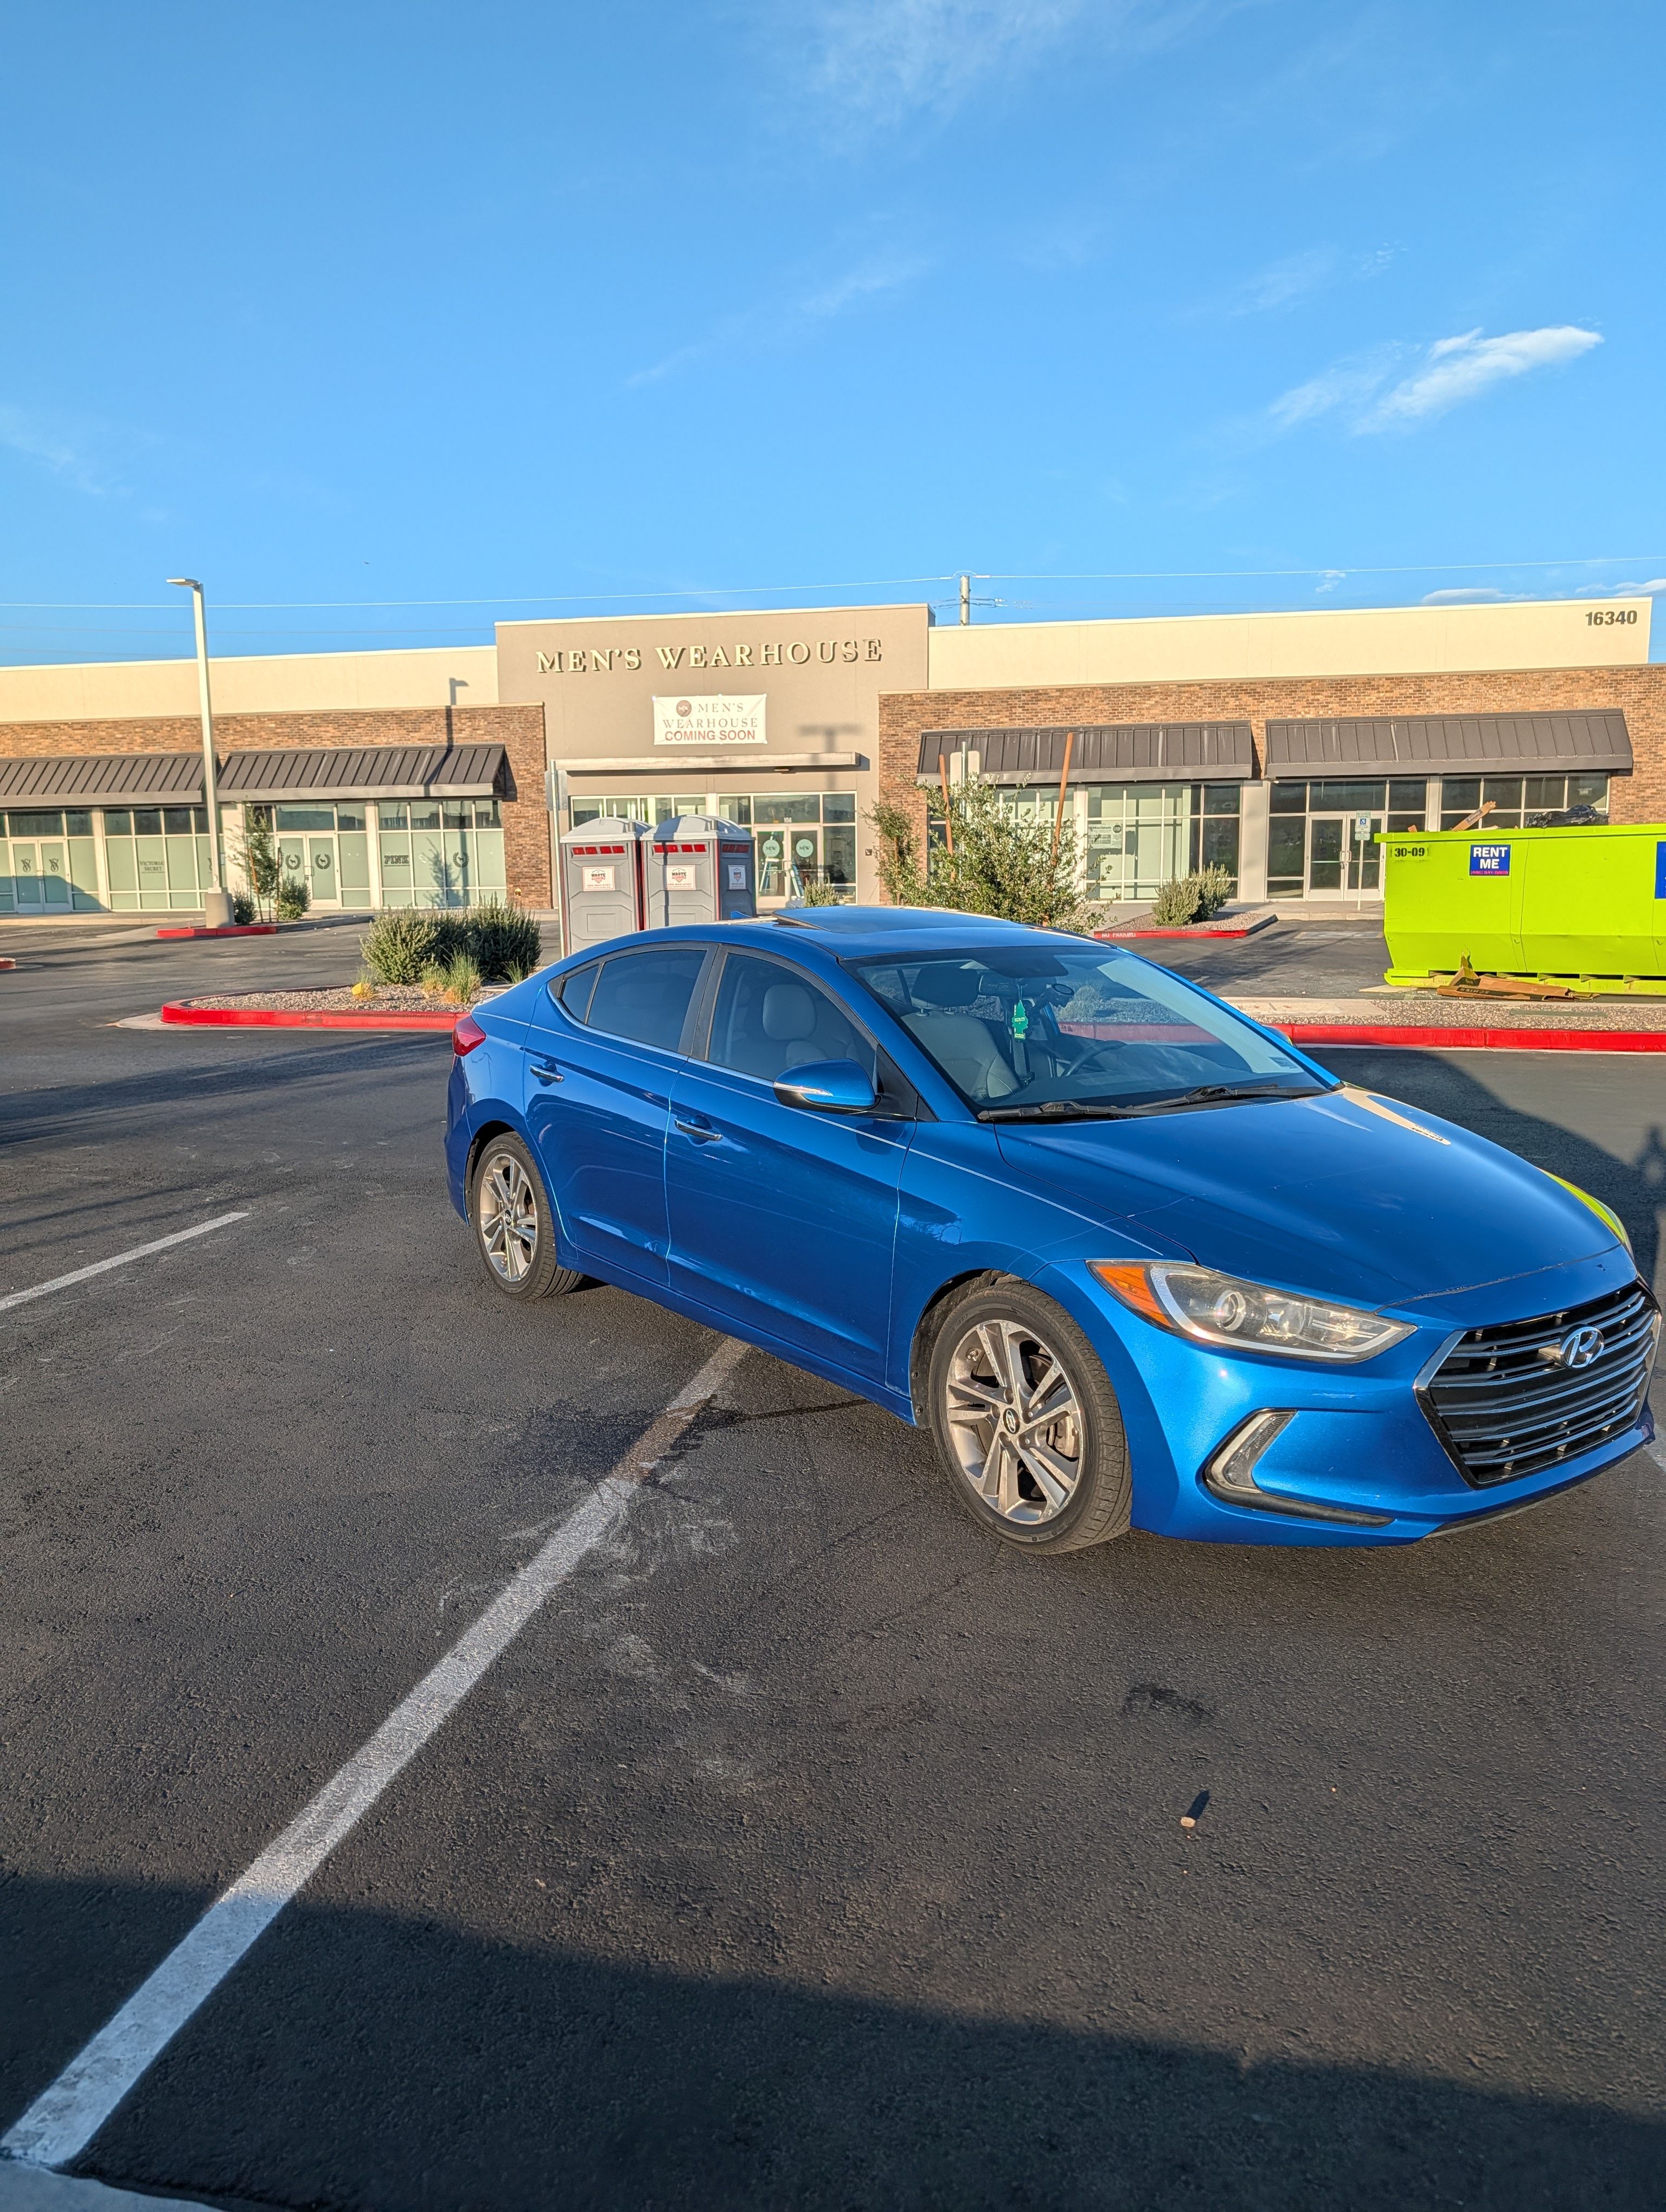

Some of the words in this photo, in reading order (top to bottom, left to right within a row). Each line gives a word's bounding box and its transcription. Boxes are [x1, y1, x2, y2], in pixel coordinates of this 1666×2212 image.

[1585, 610, 1637, 626] 16340
[535, 647, 642, 673] MEN'S
[655, 639, 884, 669] WEARHOUSE
[698, 703, 744, 713] MEN'S
[663, 718, 758, 729] WEARHOUSE
[665, 730, 716, 741] COMING
[719, 730, 755, 741] SOON
[1394, 847, 1425, 857] 30-09
[1473, 847, 1508, 858] RENT
[384, 855, 409, 864] PINK
[1479, 859, 1500, 869] ME
